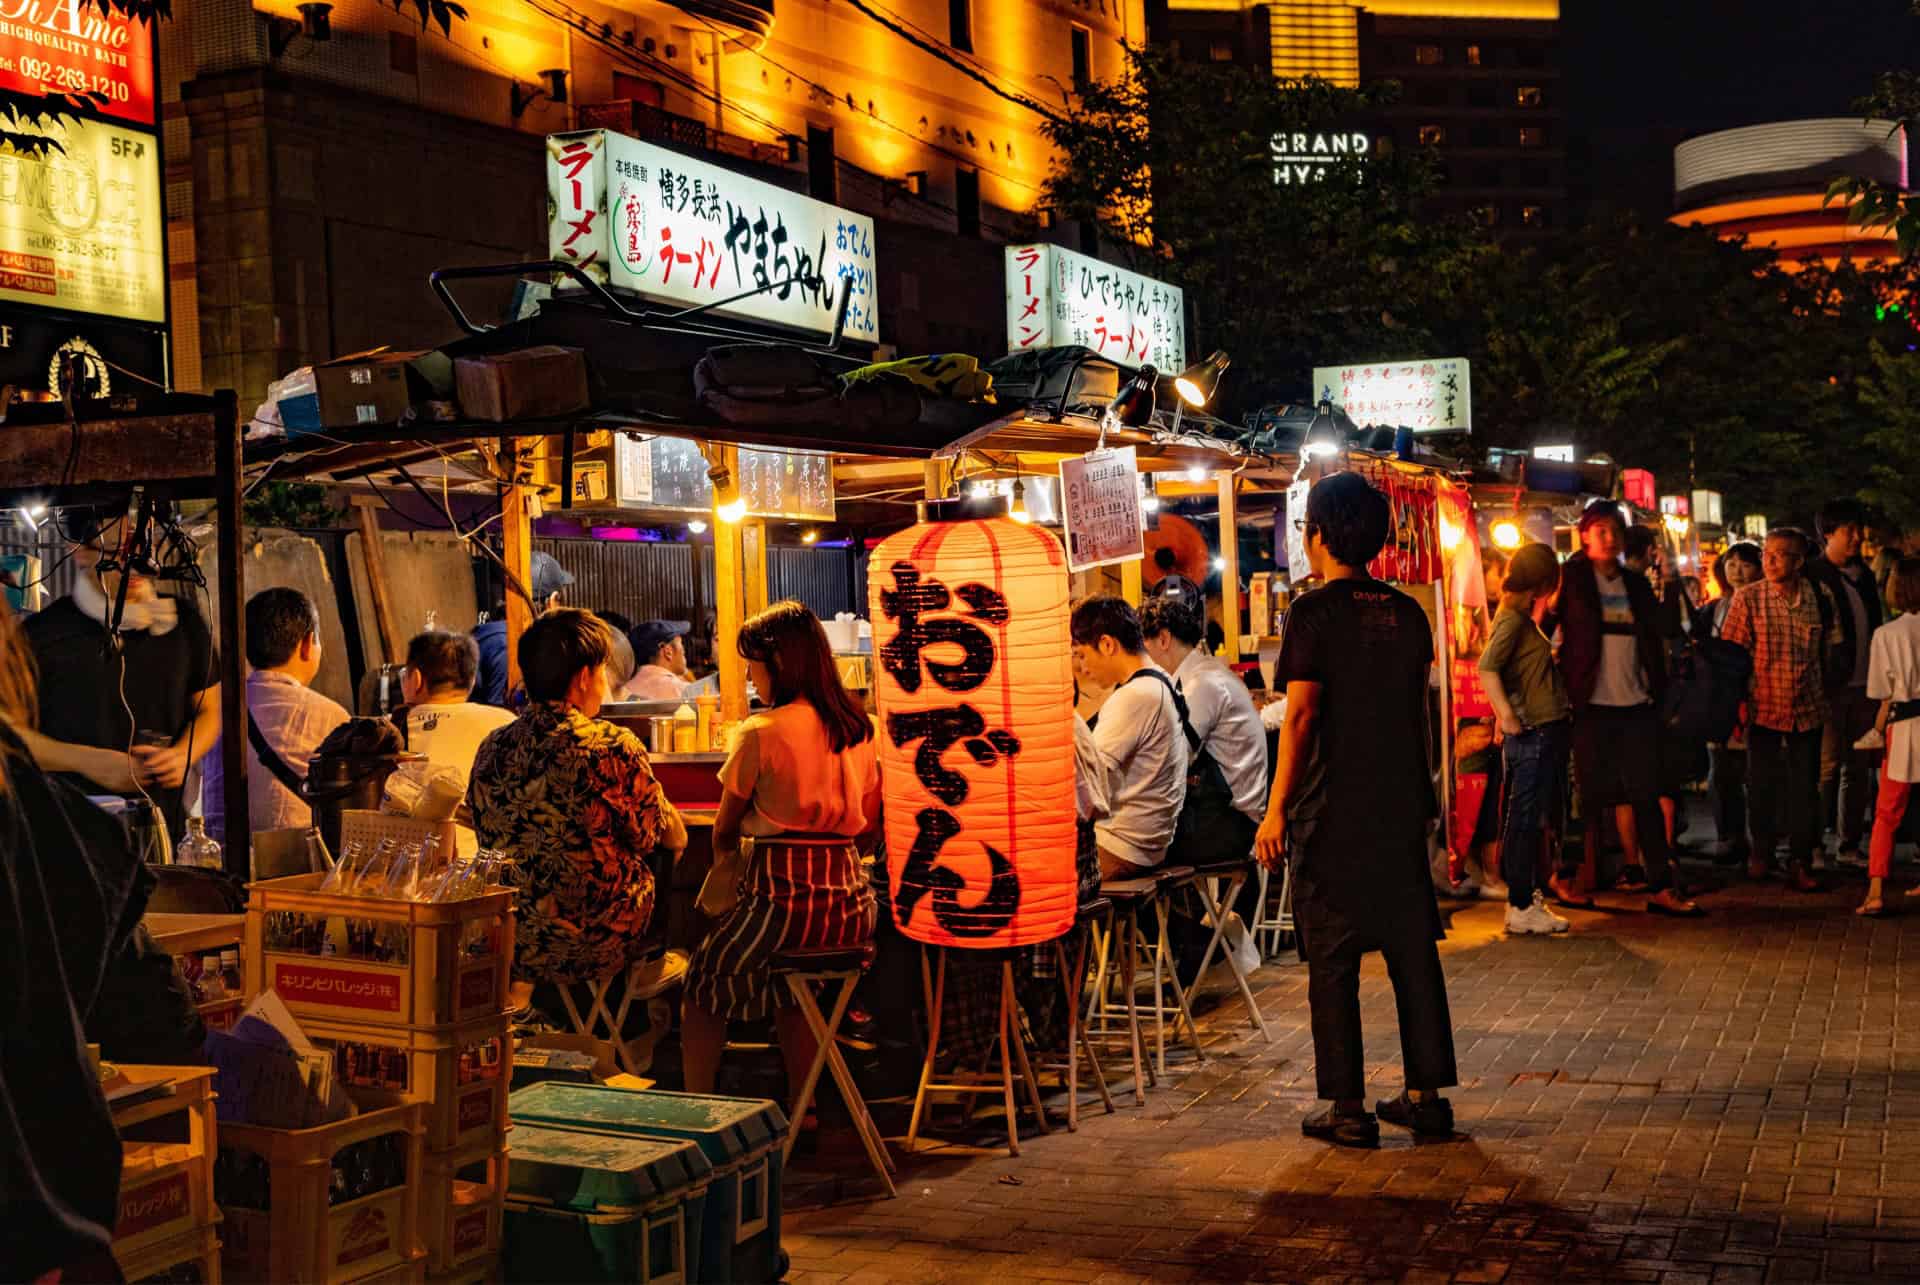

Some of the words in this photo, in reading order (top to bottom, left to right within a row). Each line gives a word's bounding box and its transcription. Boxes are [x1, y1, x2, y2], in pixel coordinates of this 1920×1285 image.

[0, 22, 89, 56] HIGHQUALITY
[94, 47, 128, 67] BATH
[19, 55, 129, 103] 092-263-1210
[110, 136, 132, 158] 5F
[1270, 133, 1369, 153] GRAND
[558, 141, 597, 279] ラーメン
[659, 167, 722, 224] 博多長浜
[659, 226, 722, 290] ラーメン
[724, 200, 834, 312] やまちゃん
[1015, 247, 1045, 347] ラーメン
[1080, 266, 1150, 317] ひでちゃん
[1093, 315, 1151, 362] ラーメン
[879, 560, 1021, 939] おでん
